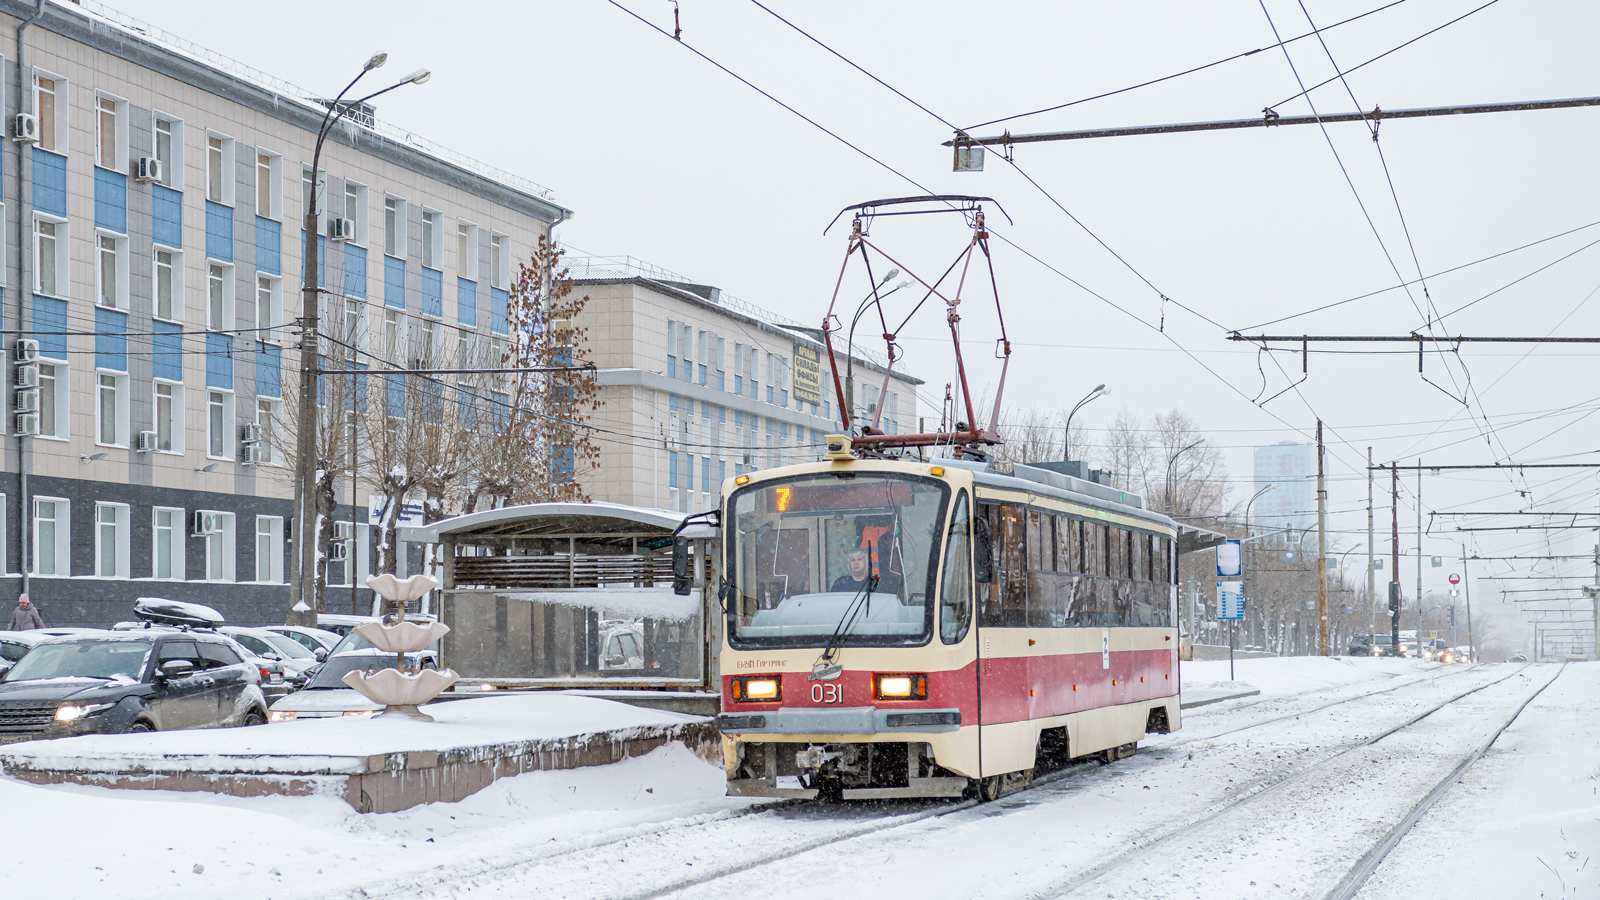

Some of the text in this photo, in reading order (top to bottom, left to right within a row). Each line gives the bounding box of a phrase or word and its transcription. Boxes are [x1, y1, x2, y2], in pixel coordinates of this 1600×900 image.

[796, 357, 819, 373] СКЛАДЫ
[797, 369, 818, 384] ОФИСЫ
[776, 488, 790, 511] 7
[811, 684, 844, 704] 031
